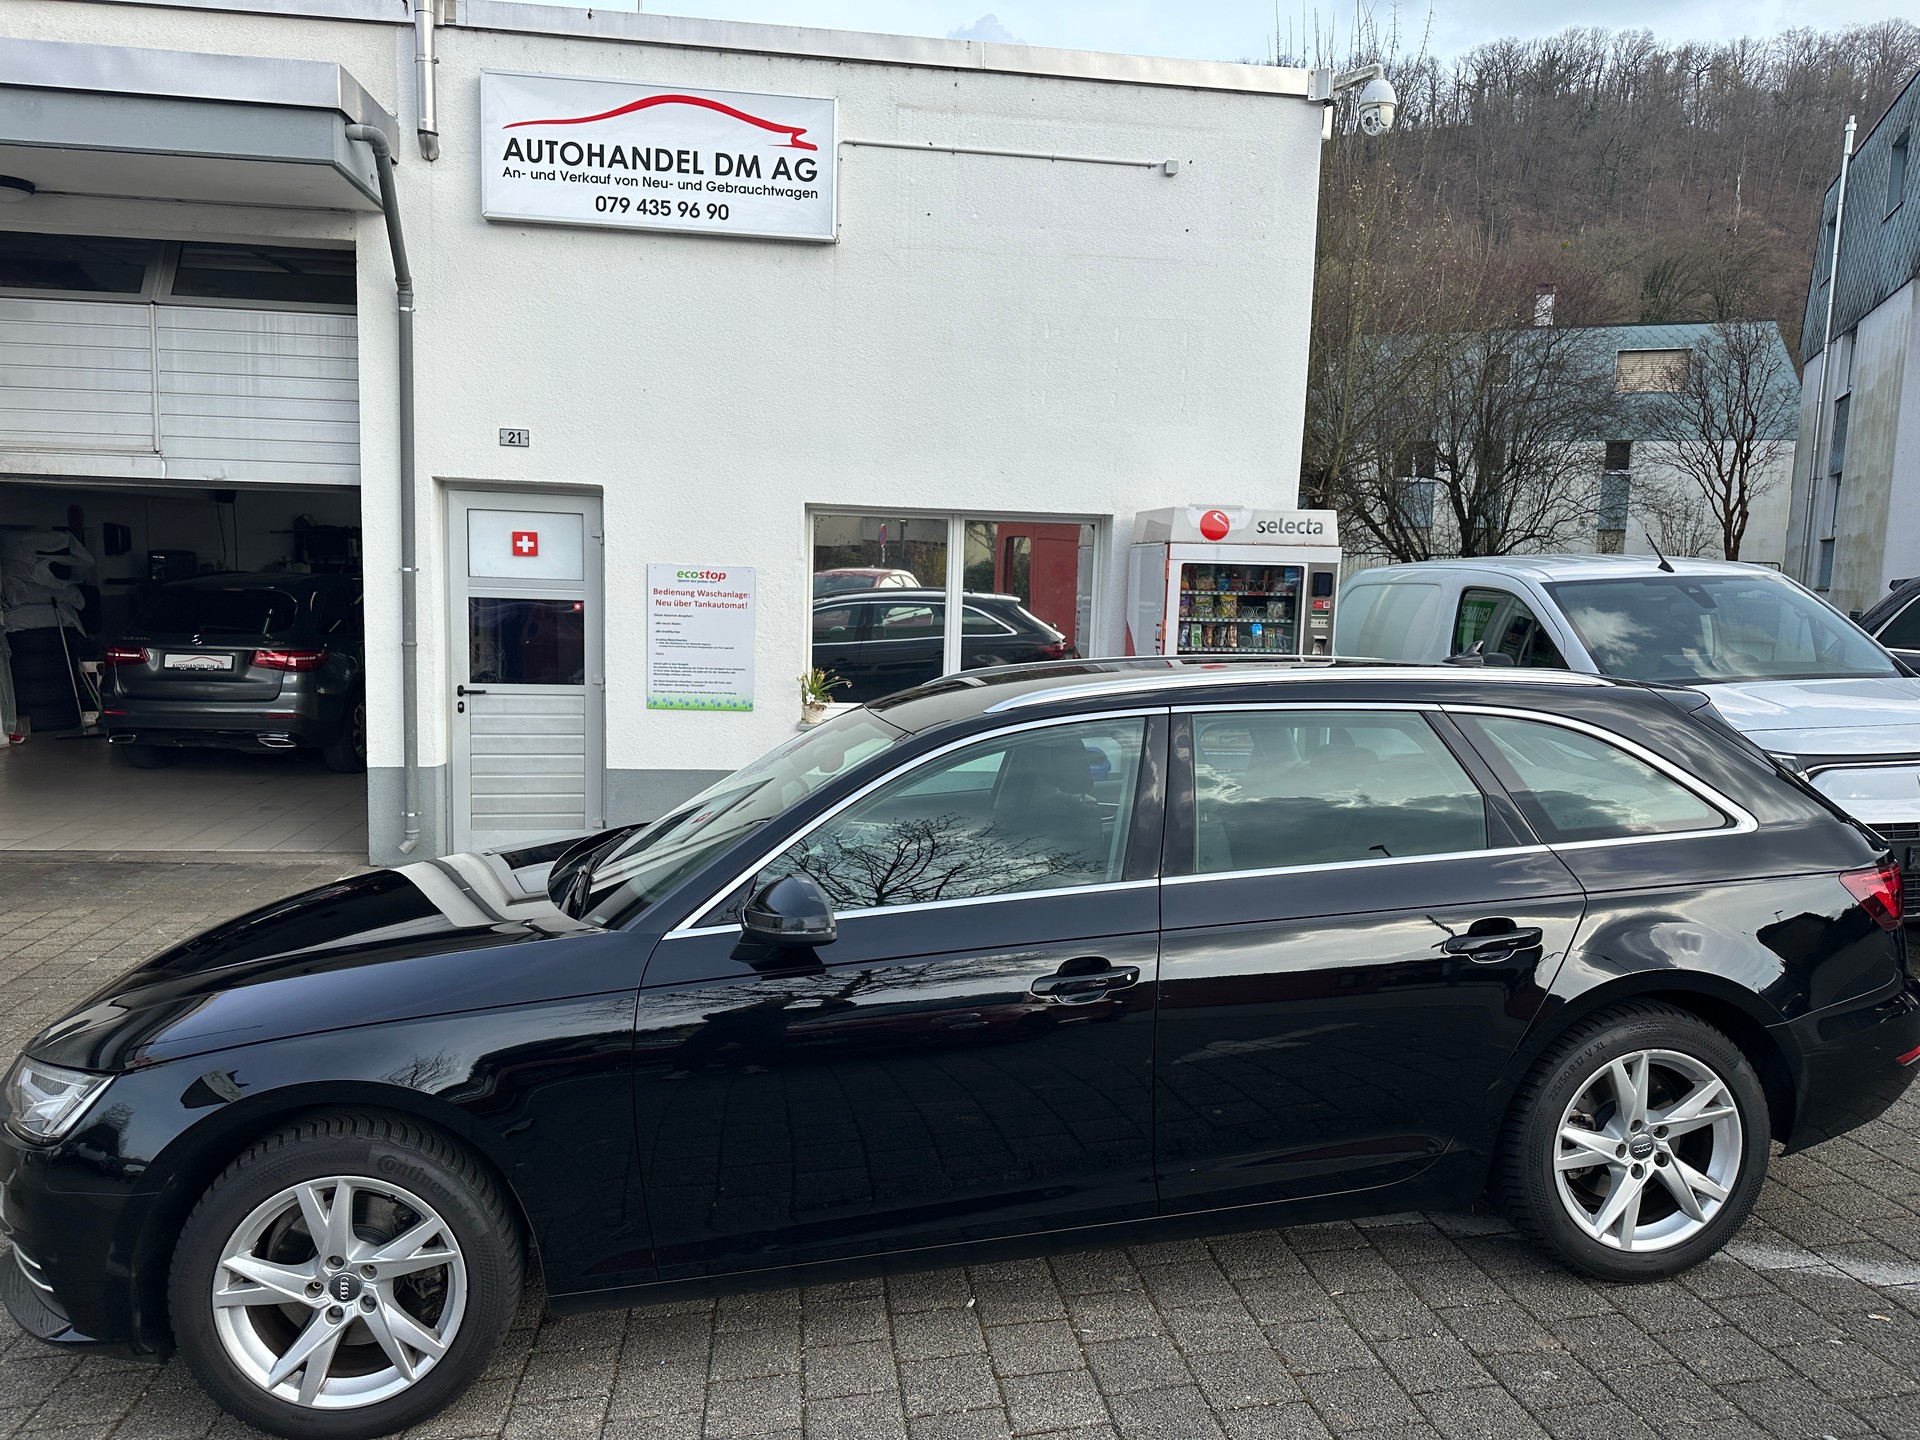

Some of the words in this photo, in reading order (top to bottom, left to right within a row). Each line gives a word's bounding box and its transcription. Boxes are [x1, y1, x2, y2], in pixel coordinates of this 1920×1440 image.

[502, 138, 704, 175] AUTOHANDEL
[715, 152, 762, 179] DM
[772, 158, 818, 183] AG
[502, 167, 526, 180] An-
[530, 169, 556, 181] und
[560, 171, 611, 185] Verkauf
[614, 177, 639, 187] von
[642, 176, 674, 190] Neu-
[677, 178, 702, 191] und
[706, 181, 818, 201] Gebrauchtwagen
[595, 196, 631, 214] 079
[636, 199, 672, 216] 435
[677, 201, 701, 219] 96
[706, 203, 730, 221] 90
[507, 431, 522, 444] 21
[1256, 518, 1324, 535] selecta
[676, 570, 727, 582] ecostop
[653, 588, 695, 598] Bedienung
[697, 590, 751, 600] Waschanlage:
[655, 599, 672, 607] Neu
[674, 599, 692, 608] über
[694, 601, 748, 610] Tankautomat!
[1548, 1071, 1571, 1101] 225/50
[1584, 1048, 1593, 1057] V
[1594, 1041, 1607, 1052] XL
